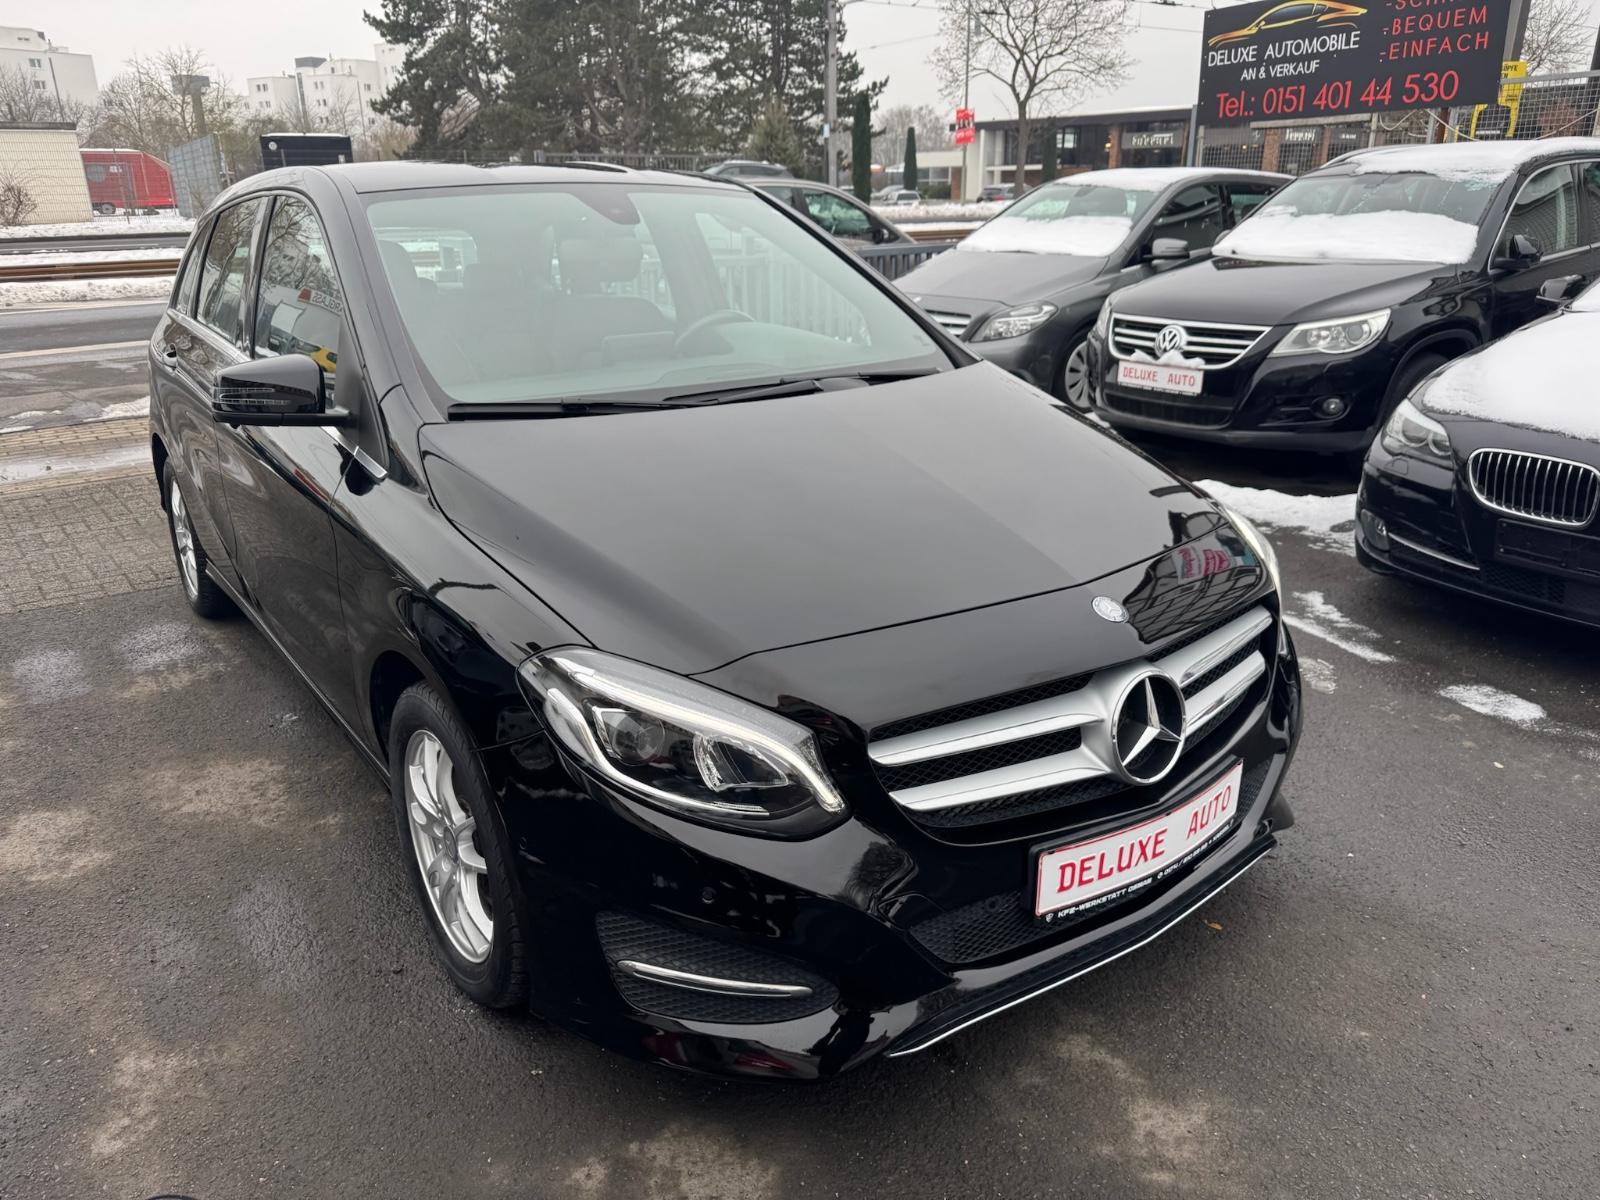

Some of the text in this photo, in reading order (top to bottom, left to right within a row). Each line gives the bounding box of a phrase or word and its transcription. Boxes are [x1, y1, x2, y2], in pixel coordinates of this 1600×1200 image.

[1207, 31, 1360, 67] DELUXE AUTOMOBILE
[1240, 59, 1320, 81] AN & VERKAUF
[1215, 69, 1460, 119] Tel.: 0151 401 44 530
[1122, 366, 1196, 387] DELUXE AUTO
[1056, 827, 1168, 894] DELUXE
[1186, 784, 1232, 841] AUTO
